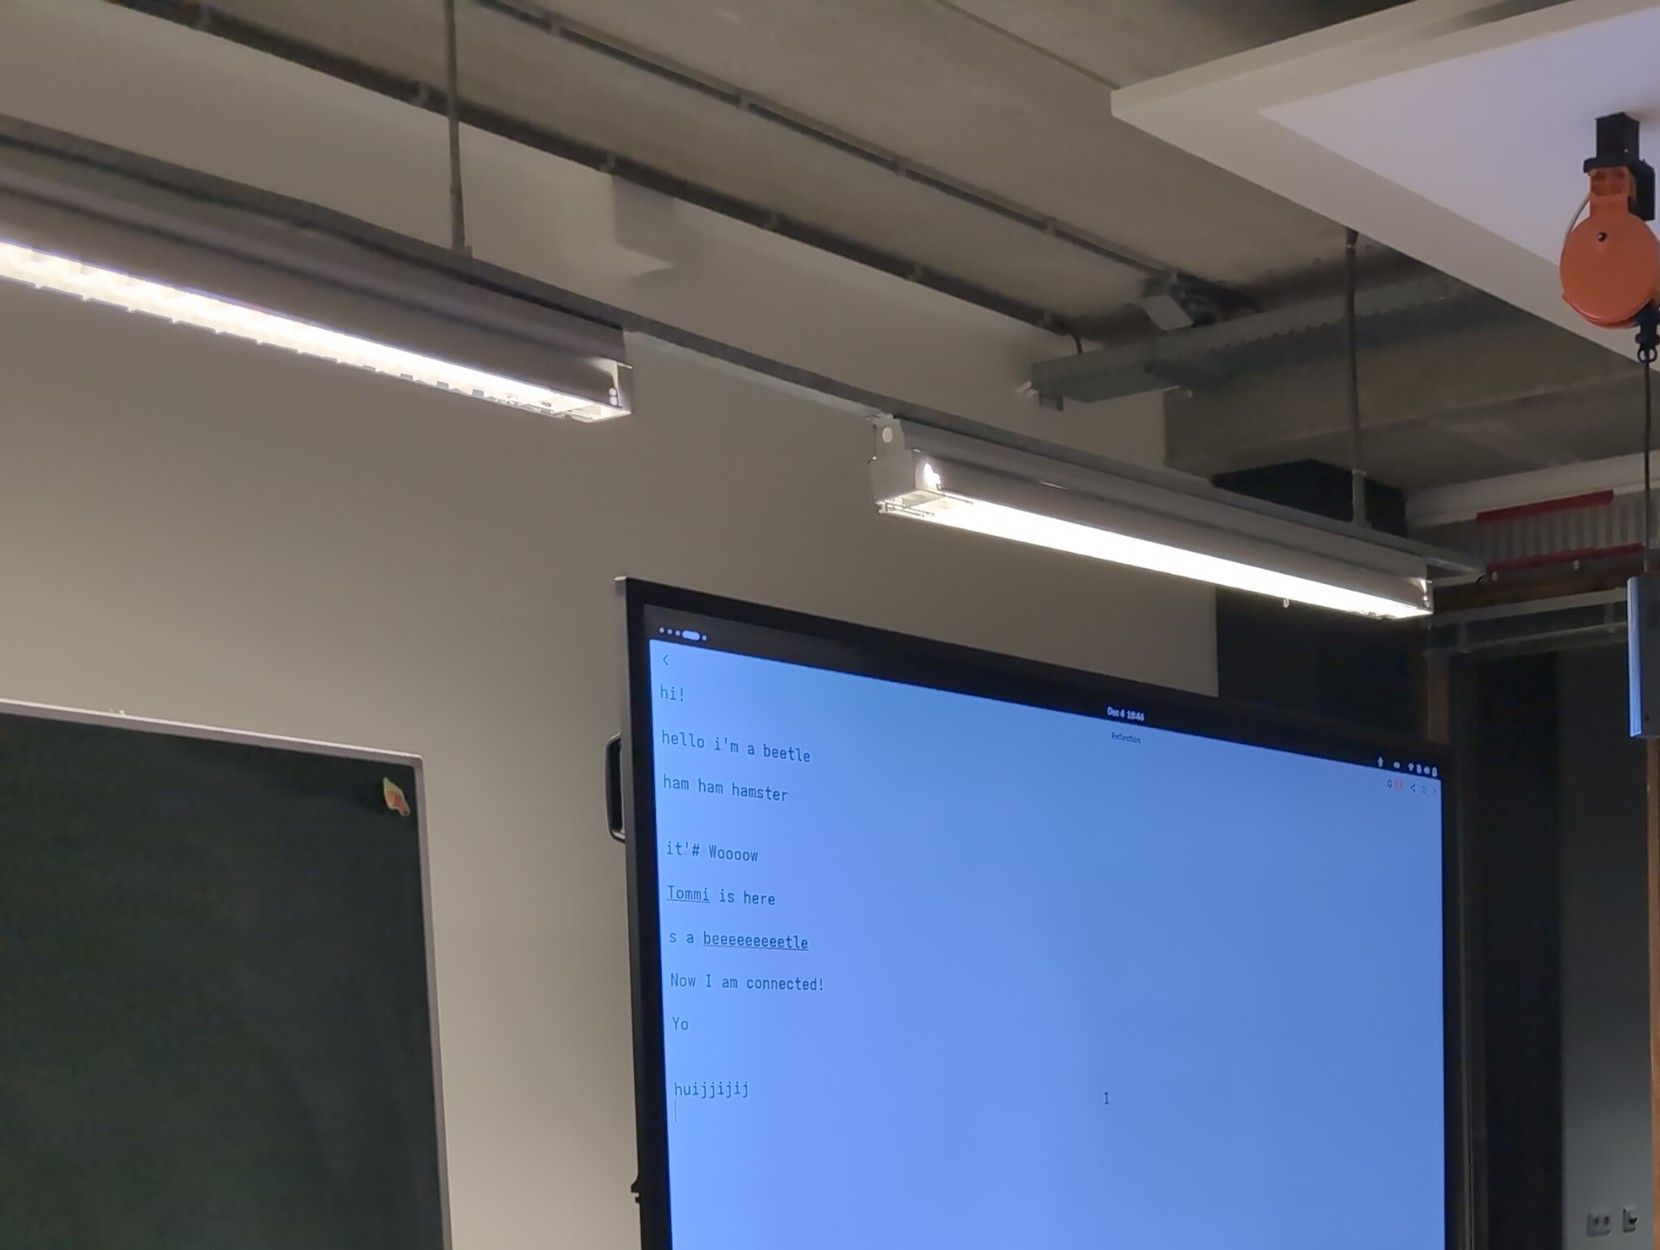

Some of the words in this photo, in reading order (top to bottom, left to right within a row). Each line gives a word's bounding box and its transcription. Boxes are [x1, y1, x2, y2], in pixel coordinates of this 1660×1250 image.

[659, 684, 684, 702] hi!
[661, 729, 705, 749] hello
[714, 736, 739, 753] i'm
[747, 744, 755, 756] a
[763, 743, 811, 763] beetle
[663, 773, 690, 791] ham
[698, 777, 724, 795] ham
[731, 781, 789, 802] hamster
[708, 844, 759, 862] Woooow
[667, 885, 710, 902] Tommi
[719, 888, 735, 903] is
[743, 890, 776, 906] here
[669, 932, 677, 944] s
[686, 933, 694, 944] a
[670, 972, 697, 988] Now
[706, 974, 712, 988] I
[722, 977, 738, 989] am
[746, 977, 825, 991] connected!
[672, 1016, 689, 1031] Yo
